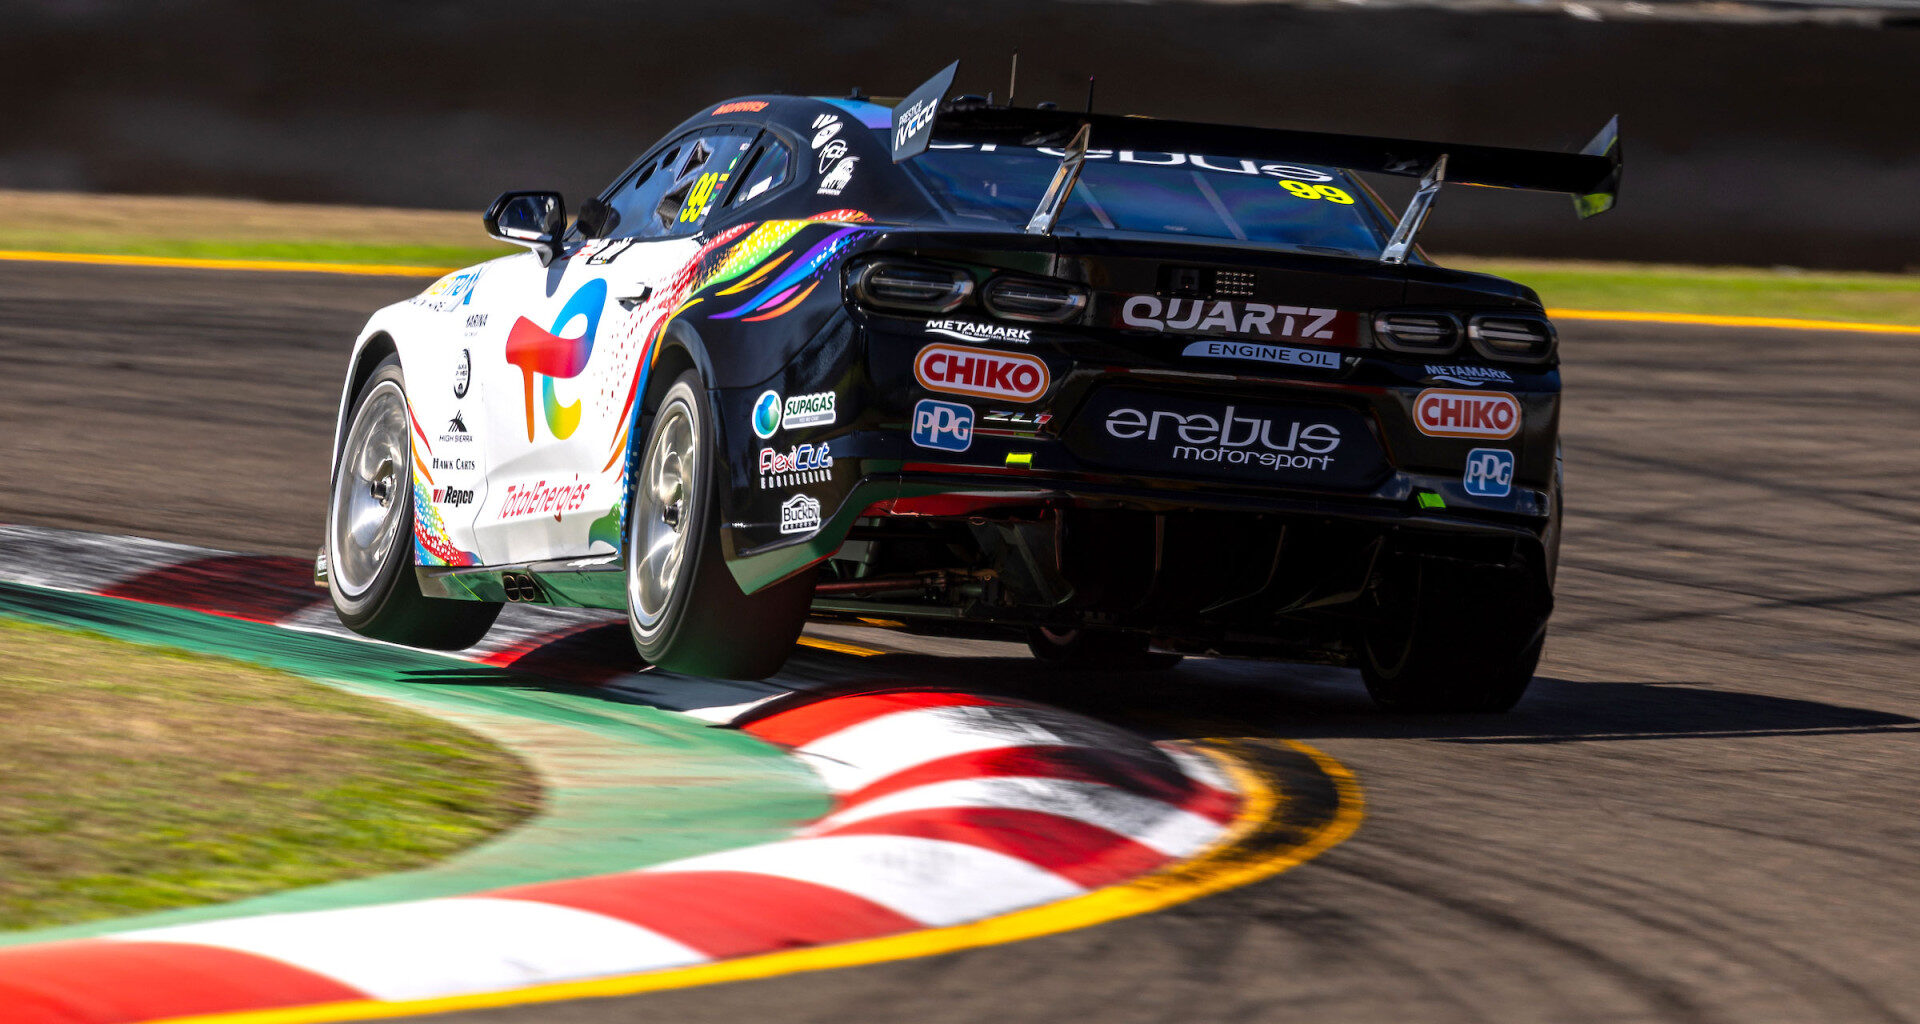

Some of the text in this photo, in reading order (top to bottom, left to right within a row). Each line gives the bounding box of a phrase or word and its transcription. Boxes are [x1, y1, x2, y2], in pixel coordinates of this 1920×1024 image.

[895, 98, 938, 151] IVECO
[680, 172, 718, 222] 99
[1279, 179, 1355, 205] 99
[925, 320, 1032, 340] METAMARK
[1122, 295, 1338, 339] QUARTZ
[1208, 343, 1333, 366] ENGINE OIL
[923, 353, 1041, 394] CHIKO
[1424, 364, 1512, 379] METAMARK
[786, 396, 834, 416] SUPAGAS
[1419, 398, 1515, 430] CHIKO
[439, 434, 473, 443] HIGH SIERRA
[916, 406, 970, 443] PPG
[1105, 406, 1341, 453] erebus
[760, 442, 830, 475] FlexiCut
[1173, 446, 1335, 471] motorsport
[1468, 453, 1512, 491] PPG
[444, 485, 474, 508] Repco
[498, 473, 591, 523] TotalEnergies
